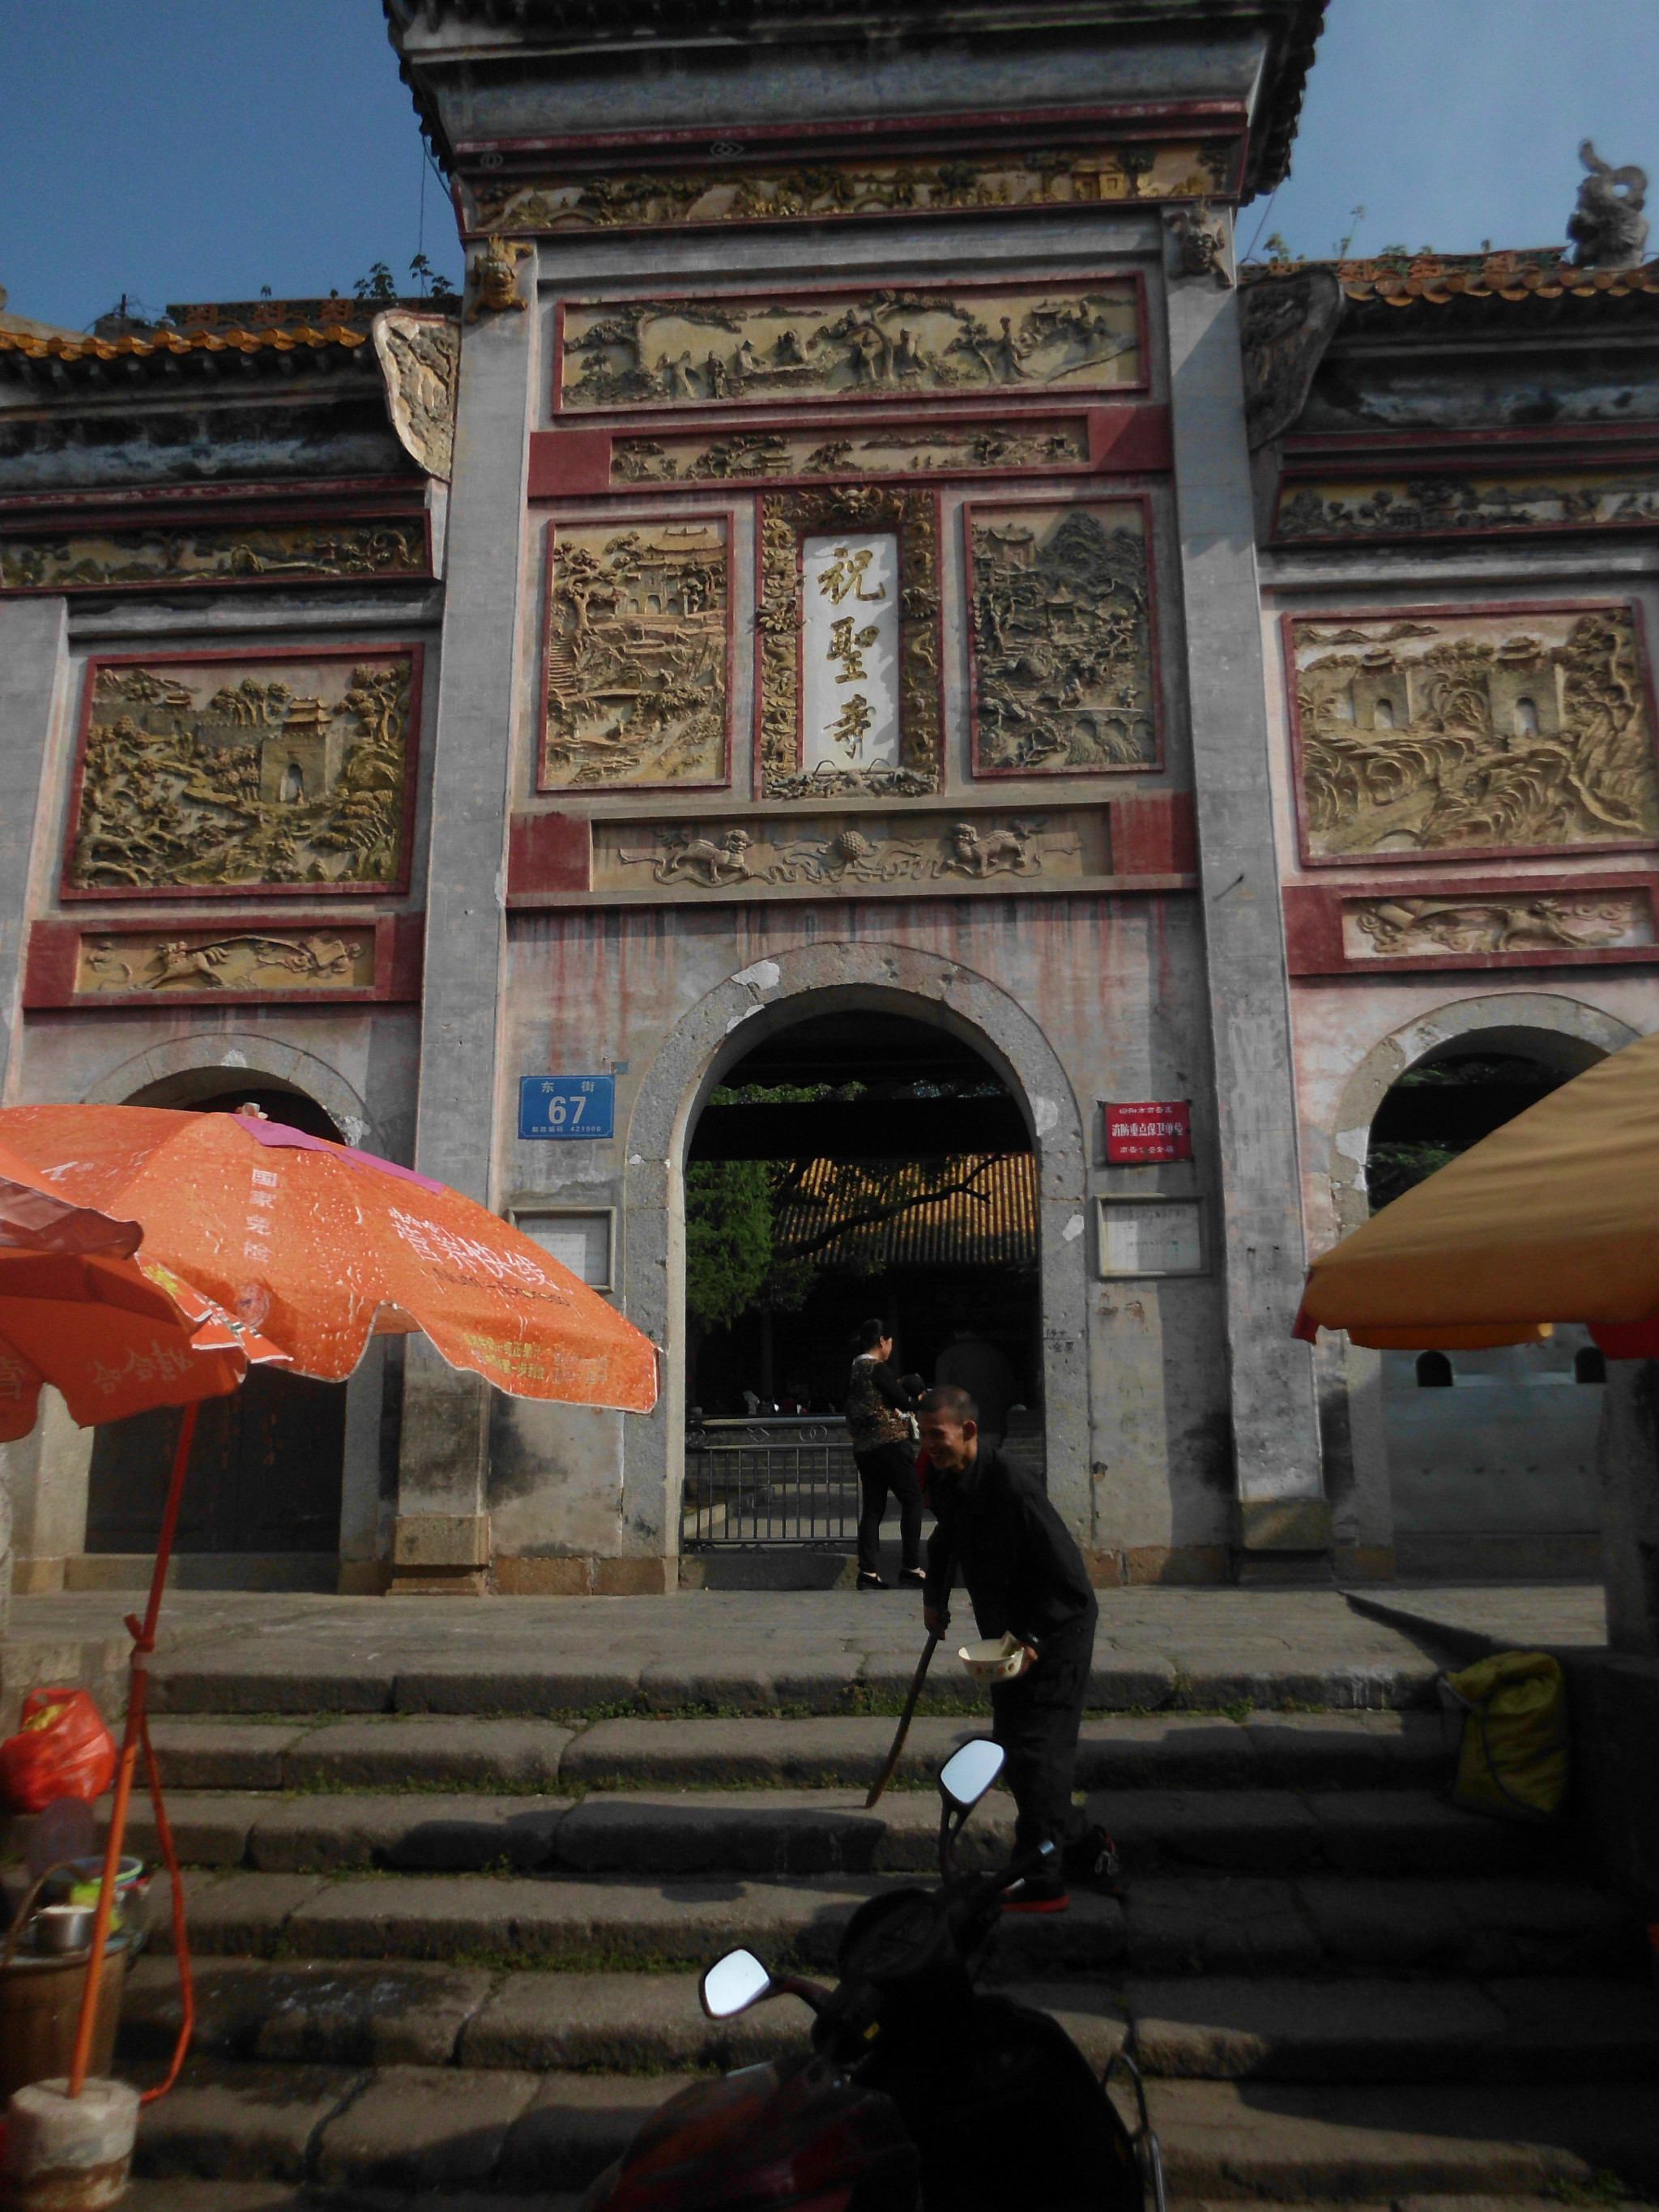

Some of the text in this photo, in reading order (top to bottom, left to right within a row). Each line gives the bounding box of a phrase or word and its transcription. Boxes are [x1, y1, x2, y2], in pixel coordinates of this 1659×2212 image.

[817, 547, 886, 760] 祝聖寺
[541, 1080, 595, 1093] 东街
[548, 1096, 586, 1124] 67
[1111, 1122, 1183, 1137] 消防重点保卫单位
